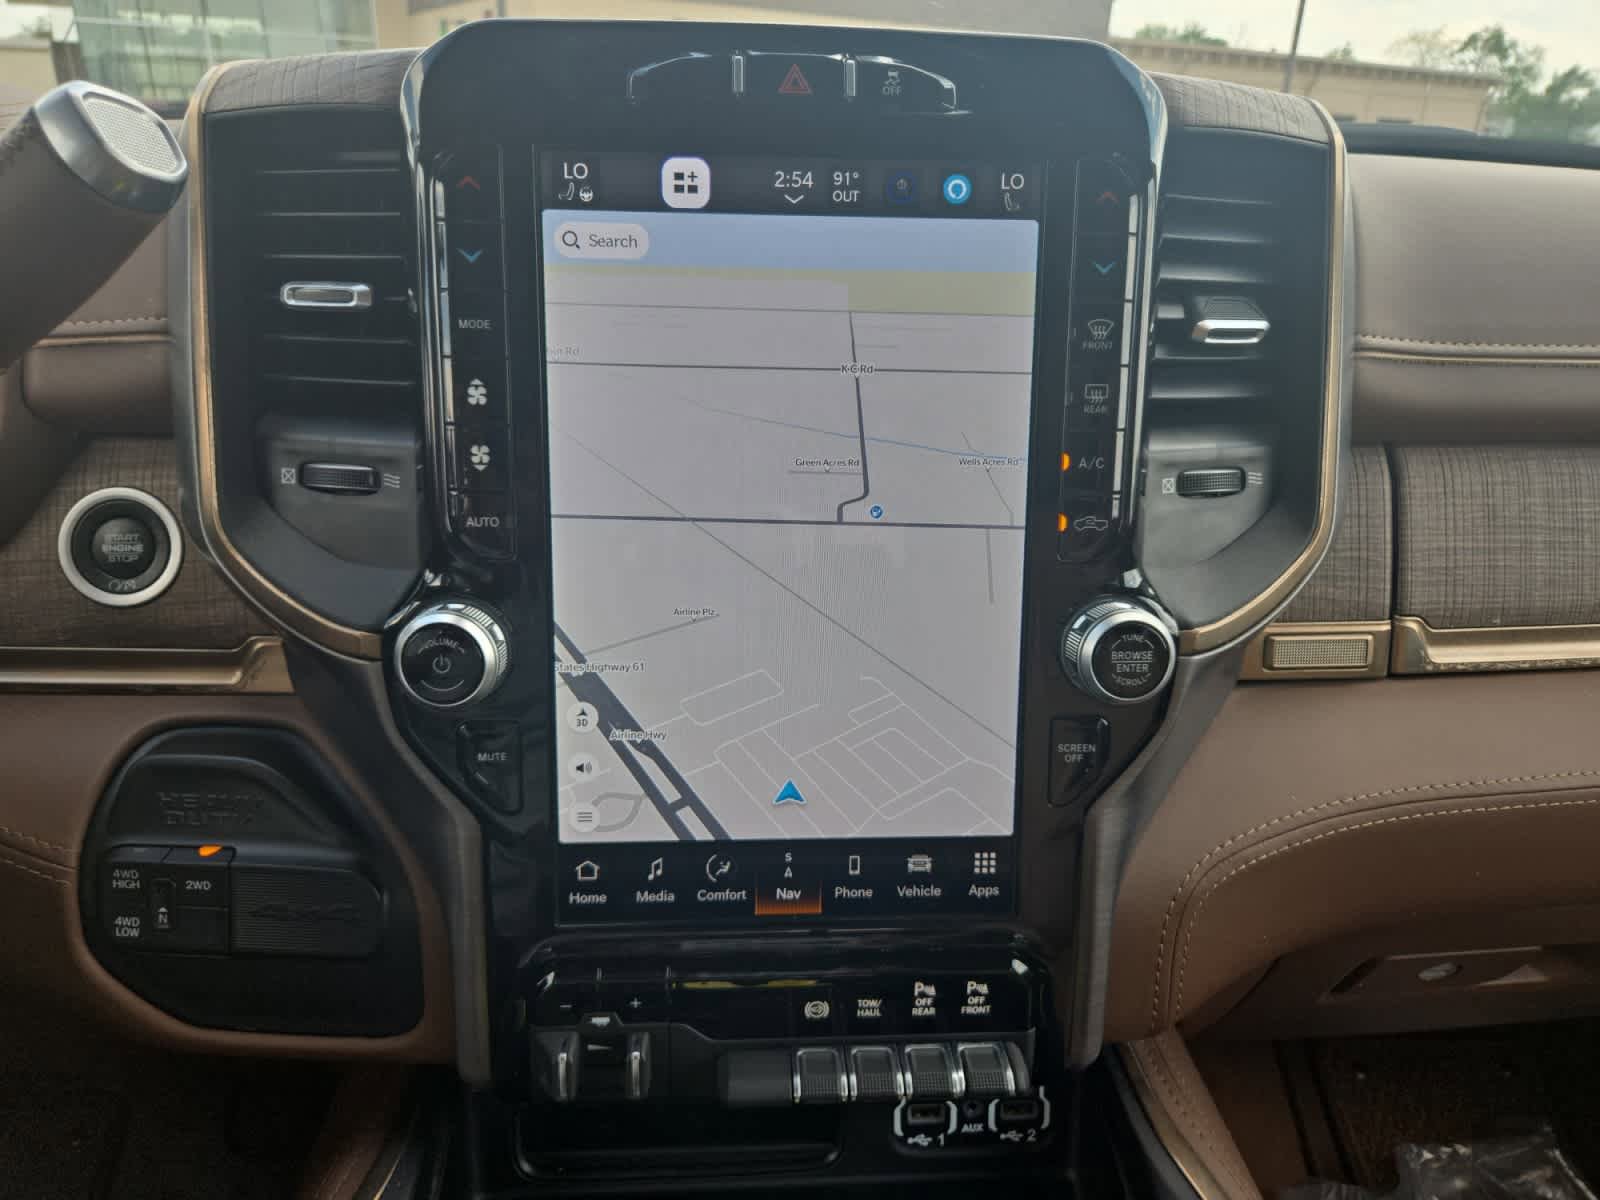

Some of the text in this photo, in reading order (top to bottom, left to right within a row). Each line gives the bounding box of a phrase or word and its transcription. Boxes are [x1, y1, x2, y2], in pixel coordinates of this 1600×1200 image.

[882, 86, 902, 96] OFF
[563, 162, 589, 179] LO
[774, 171, 814, 188] 2:54
[833, 171, 860, 186] 91°
[1001, 173, 1025, 190] LO
[832, 190, 861, 203] OUT
[588, 233, 638, 249] Search
[458, 319, 491, 329] MODE
[860, 364, 874, 374] Rd
[795, 458, 860, 467] Green Acres Rd
[958, 457, 1019, 466] Wells Acres Rd
[1078, 457, 1105, 469] A/C
[466, 516, 500, 528] AUTO
[673, 607, 701, 617] Airline
[1121, 634, 1145, 643] TUNE
[424, 638, 460, 650] VOLUME
[1111, 650, 1153, 660] BROWSE
[587, 661, 630, 674] Highway
[632, 662, 646, 672] 61
[1116, 663, 1150, 673] ENTER
[1114, 675, 1149, 687] SCROLL
[576, 718, 588, 727] 3D
[610, 729, 667, 742] Airline Hwy
[1057, 743, 1096, 752] SCREEN
[477, 752, 507, 761] MUTE
[1064, 753, 1084, 763] OFF
[113, 869, 140, 879] 4WD
[112, 880, 141, 889] HIGH
[185, 880, 212, 890] 2WD
[696, 888, 747, 901] Comfort
[776, 887, 802, 900] Nav
[834, 886, 873, 898] Phone
[896, 884, 942, 897] Vehicle
[968, 884, 1000, 898] Apps
[568, 892, 608, 904] Home
[635, 890, 675, 902] Media
[114, 916, 141, 927] 4WD
[158, 914, 168, 924] N
[115, 927, 140, 937] LOW
[857, 999, 883, 1008] TOW/
[915, 997, 934, 1007] OFF
[967, 995, 986, 1005] OFF
[857, 1008, 883, 1017] HAUL
[912, 1007, 936, 1016] REAR
[961, 1005, 992, 1014] FRONT
[961, 1123, 985, 1133] AUX
[937, 1133, 945, 1146] 1
[1026, 1129, 1037, 1142] 2
